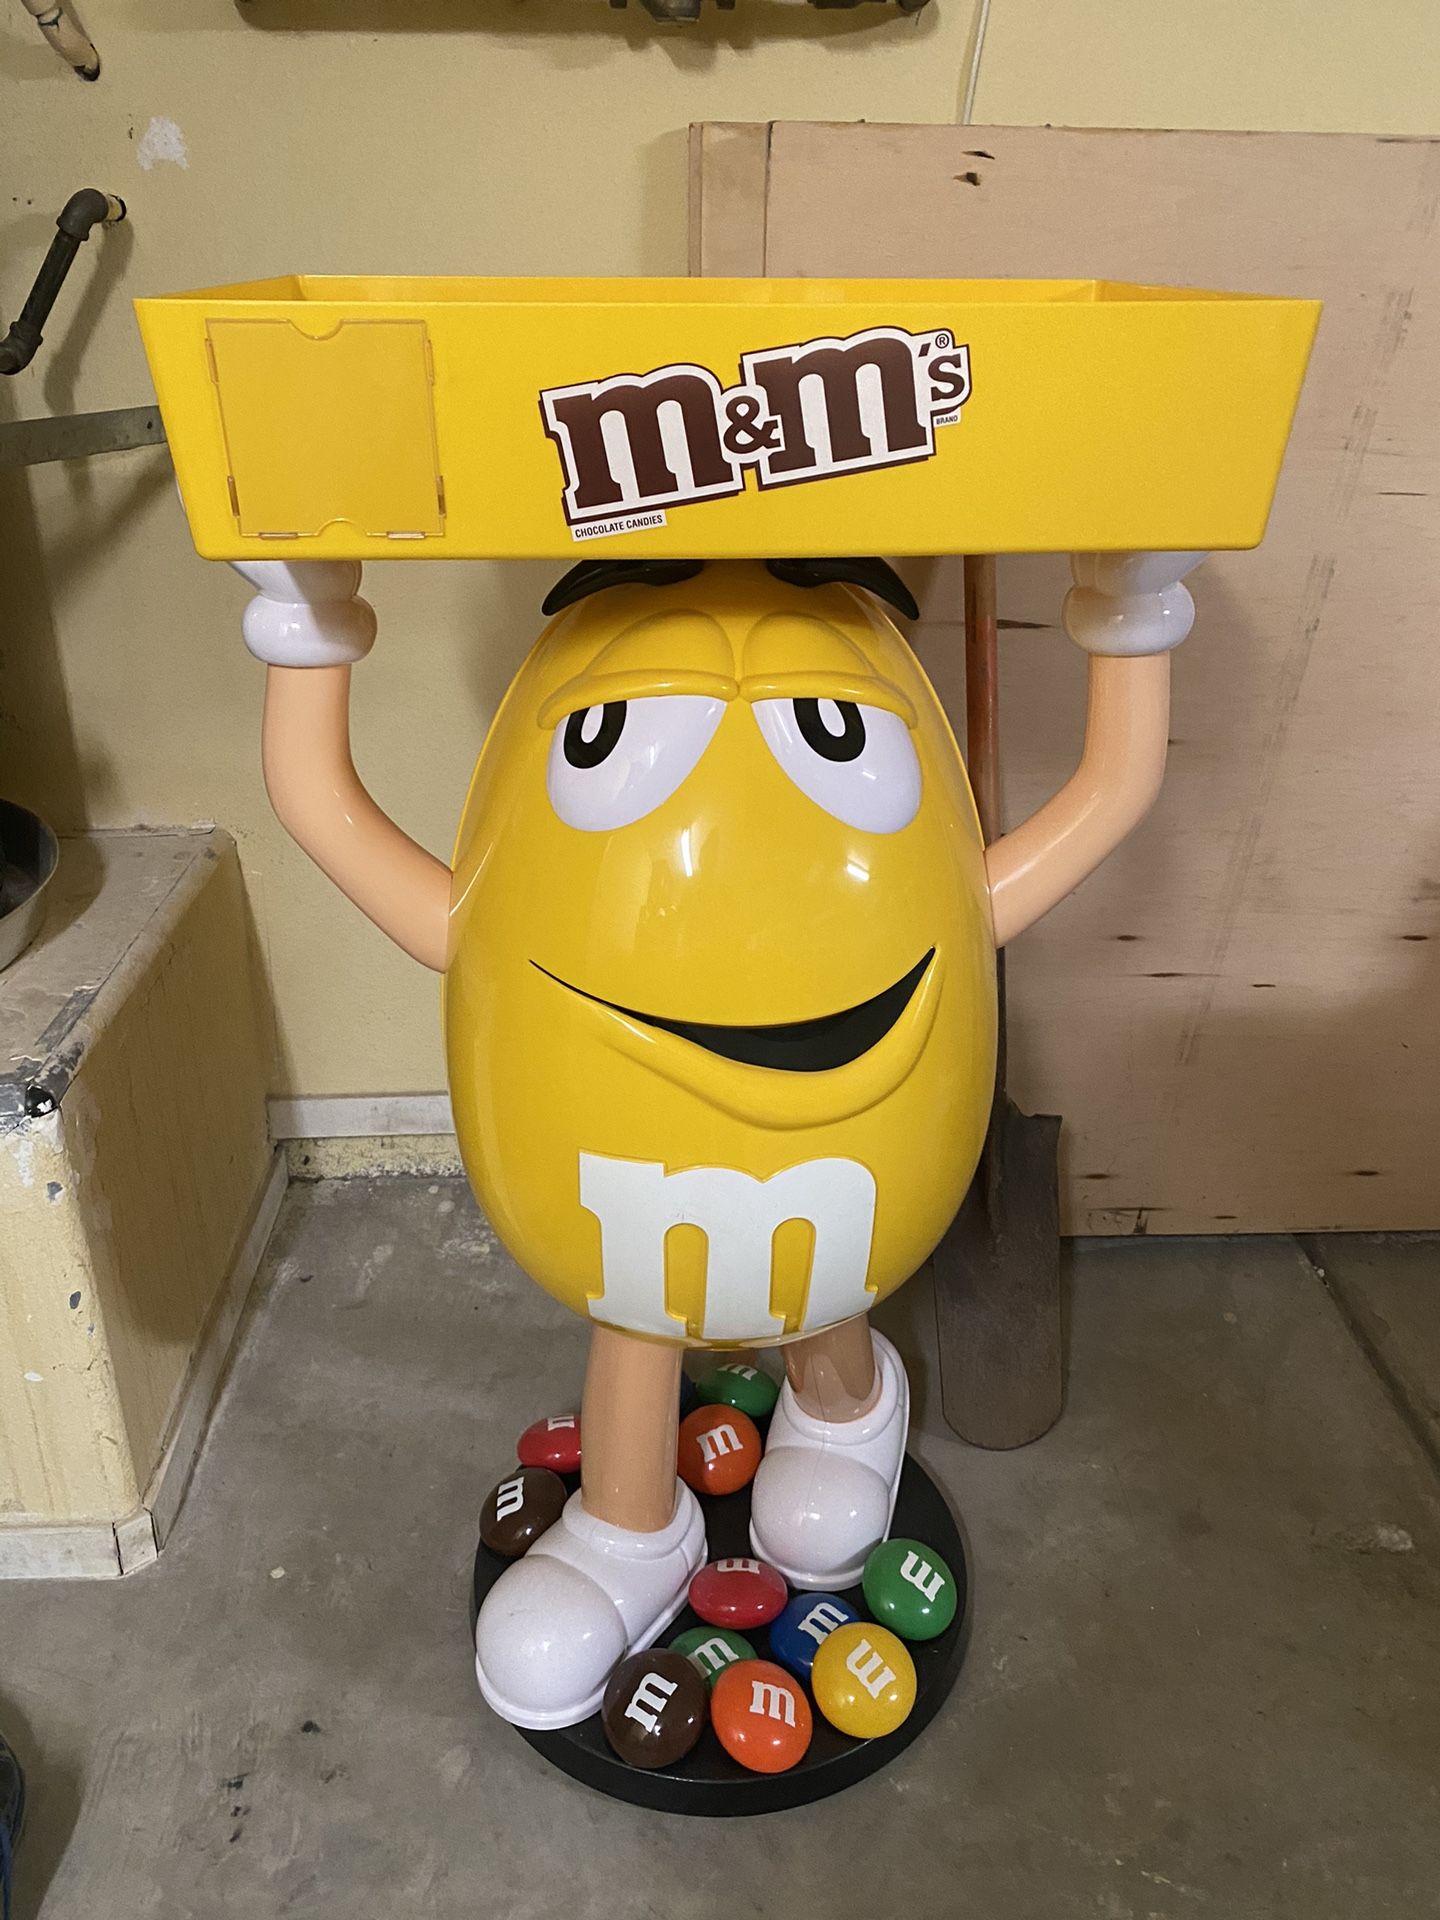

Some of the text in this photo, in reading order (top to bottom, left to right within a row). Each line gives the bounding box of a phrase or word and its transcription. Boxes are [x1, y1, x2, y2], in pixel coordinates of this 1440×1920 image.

[936, 415, 958, 425] BRAND
[575, 514, 663, 538] CHOCOLATE CANDIES
[579, 1151, 878, 1345] m
[696, 1423, 743, 1463] m
[496, 1476, 525, 1521] m
[900, 1550, 945, 1602] m
[798, 1602, 849, 1645] m
[692, 1637, 739, 1677] m
[845, 1639, 896, 1699] m
[625, 1672, 678, 1732] m
[750, 1680, 796, 1727] m
